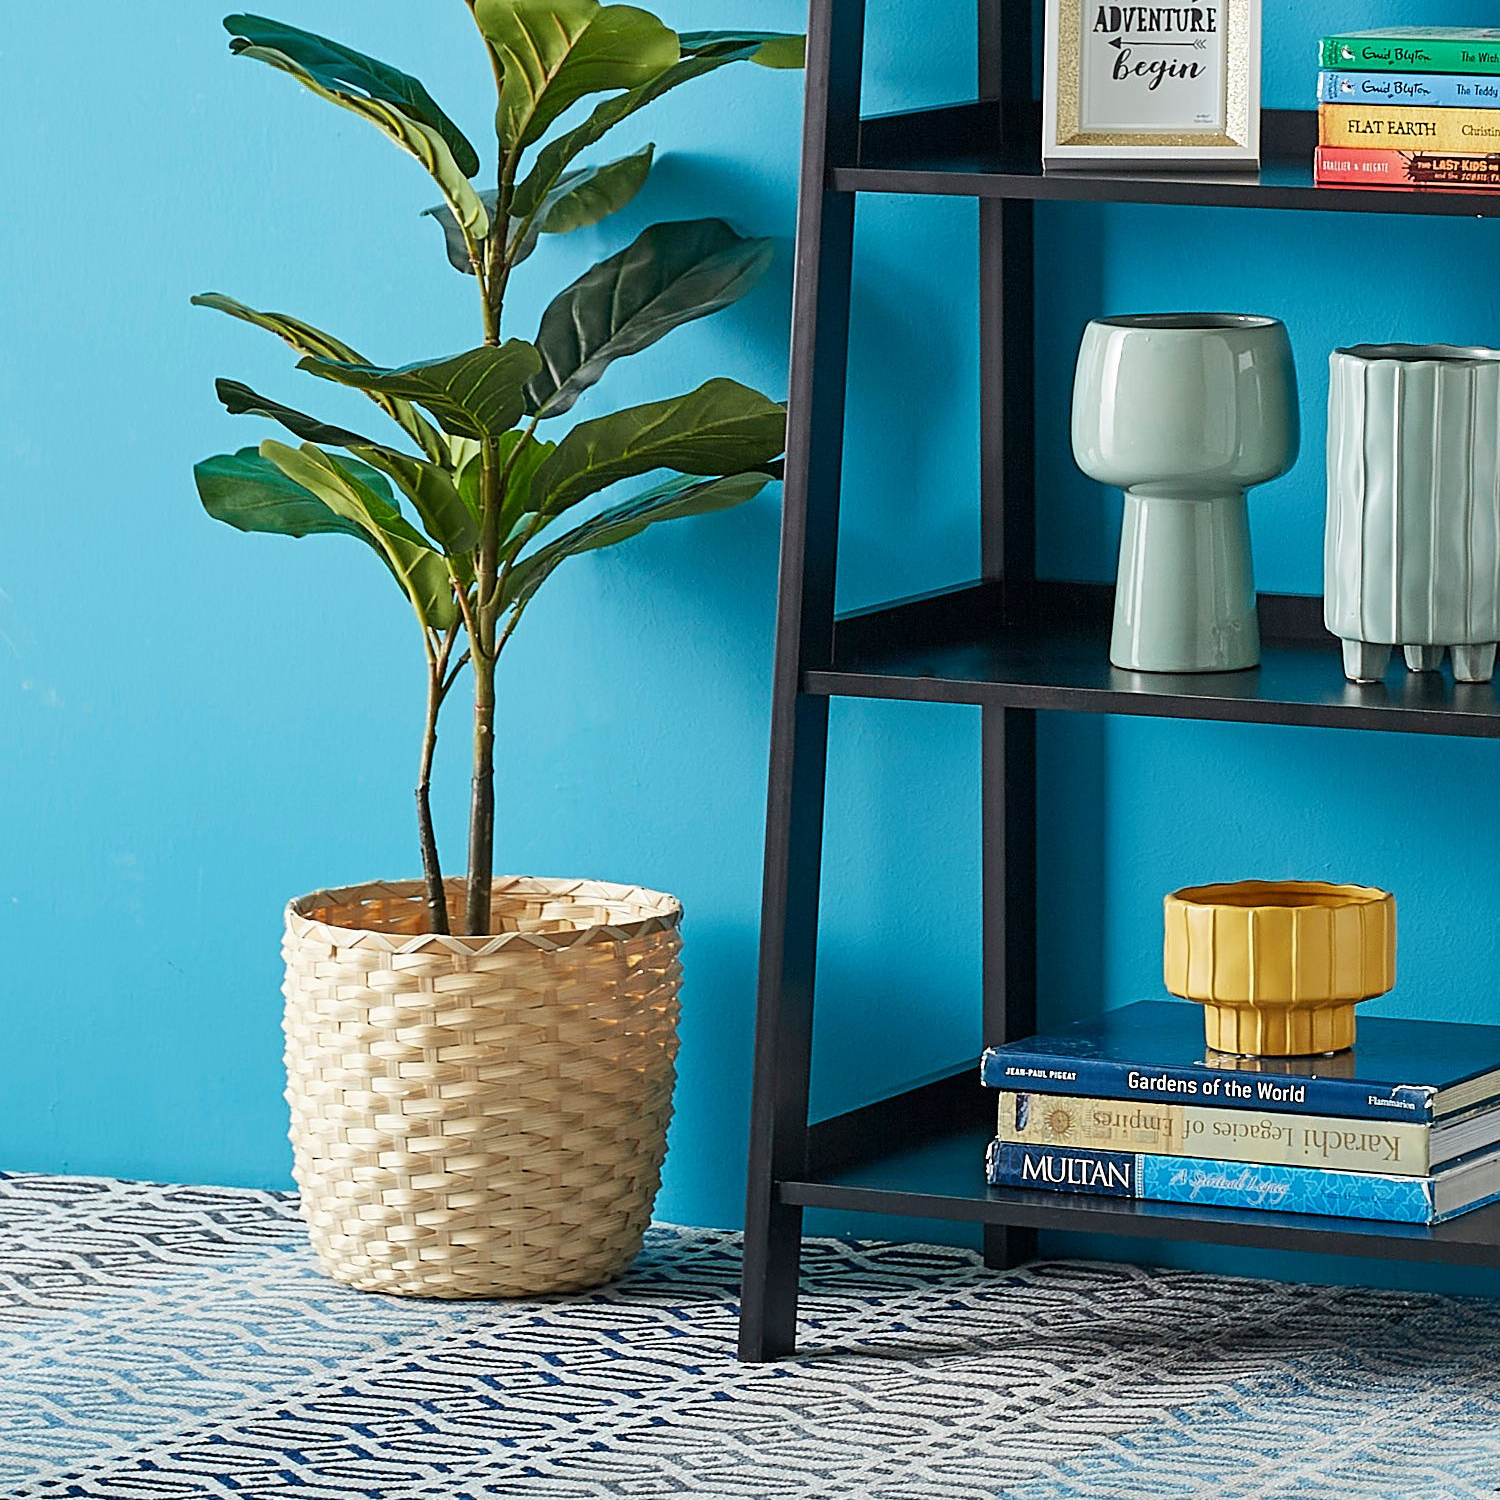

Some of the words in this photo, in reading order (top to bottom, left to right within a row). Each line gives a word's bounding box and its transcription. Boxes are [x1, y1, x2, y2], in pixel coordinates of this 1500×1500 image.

[1092, 5, 1217, 33] ADVENTURE
[1361, 46, 1391, 60] Enid
[1394, 47, 1431, 64] Blyton
[1461, 51, 1476, 63] The
[1112, 48, 1206, 91] begin
[1361, 80, 1391, 94] Enid
[1394, 81, 1431, 97] Blyton
[1456, 84, 1471, 96] The
[1474, 85, 1498, 98] Teddy
[1348, 120, 1384, 134] FLAT
[1387, 121, 1436, 136] EARTH
[1432, 159, 1460, 171] LAST
[1461, 160, 1487, 172] KIDS
[1005, 1067, 1048, 1079] JEAN-PAUL
[1128, 1071, 1198, 1094] Gardens
[1202, 1078, 1221, 1096] of
[1224, 1080, 1252, 1098] the
[1257, 1082, 1305, 1103] World
[1368, 1096, 1416, 1110] Flammarion
[1093, 1109, 1175, 1137] Empires
[1182, 1119, 1205, 1140] of
[1213, 1119, 1293, 1147] Legacies
[1304, 1126, 1402, 1162] Karachi
[1022, 1153, 1132, 1189] MULTAN
[1170, 1168, 1188, 1185] A
